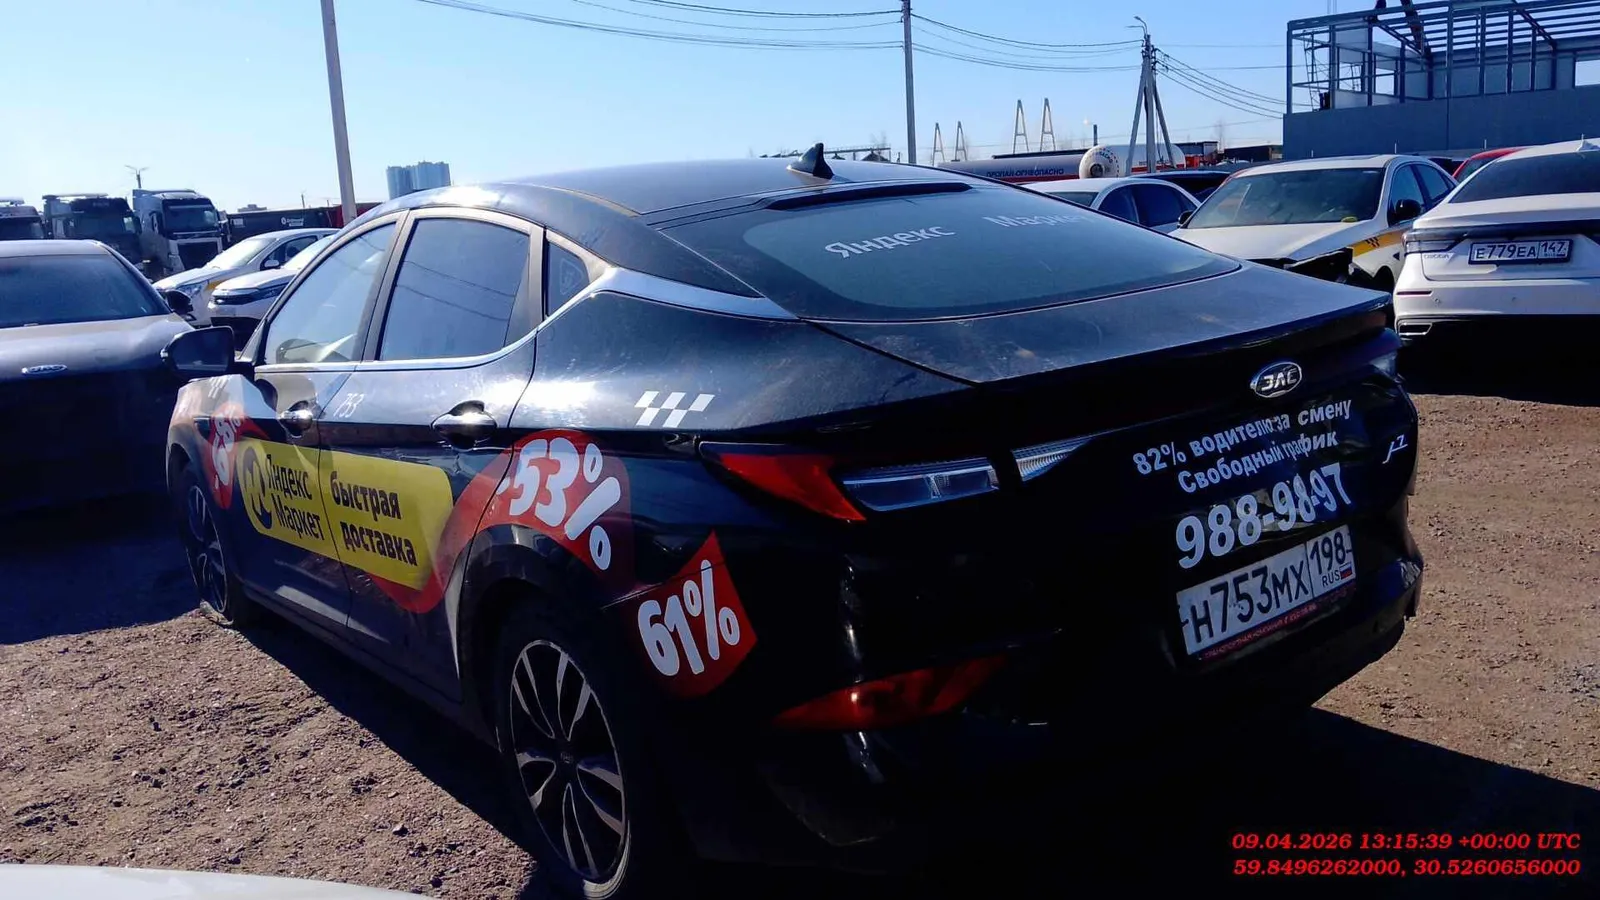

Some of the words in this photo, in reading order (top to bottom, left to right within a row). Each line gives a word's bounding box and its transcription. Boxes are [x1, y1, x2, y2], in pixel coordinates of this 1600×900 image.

[825, 226, 956, 259] Яндекс
[1476, 244, 1536, 260] Е779ЕА
[333, 392, 364, 418] 753
[1132, 441, 1187, 475] 82%
[1189, 419, 1275, 458] водителю
[1275, 413, 1290, 432] за
[1297, 399, 1351, 426] смену
[265, 453, 313, 500] Яндекс
[1177, 441, 1284, 494] Свободный
[1281, 431, 1339, 462] график
[271, 493, 325, 541] Маркет
[330, 470, 402, 522] быстрая
[1175, 462, 1352, 569] 988-98-97
[339, 520, 418, 567] доставка
[1190, 560, 1309, 643] Н753МХ
[1309, 532, 1346, 574] 198
[1322, 570, 1341, 587] RUS
[637, 559, 741, 677] 61%
